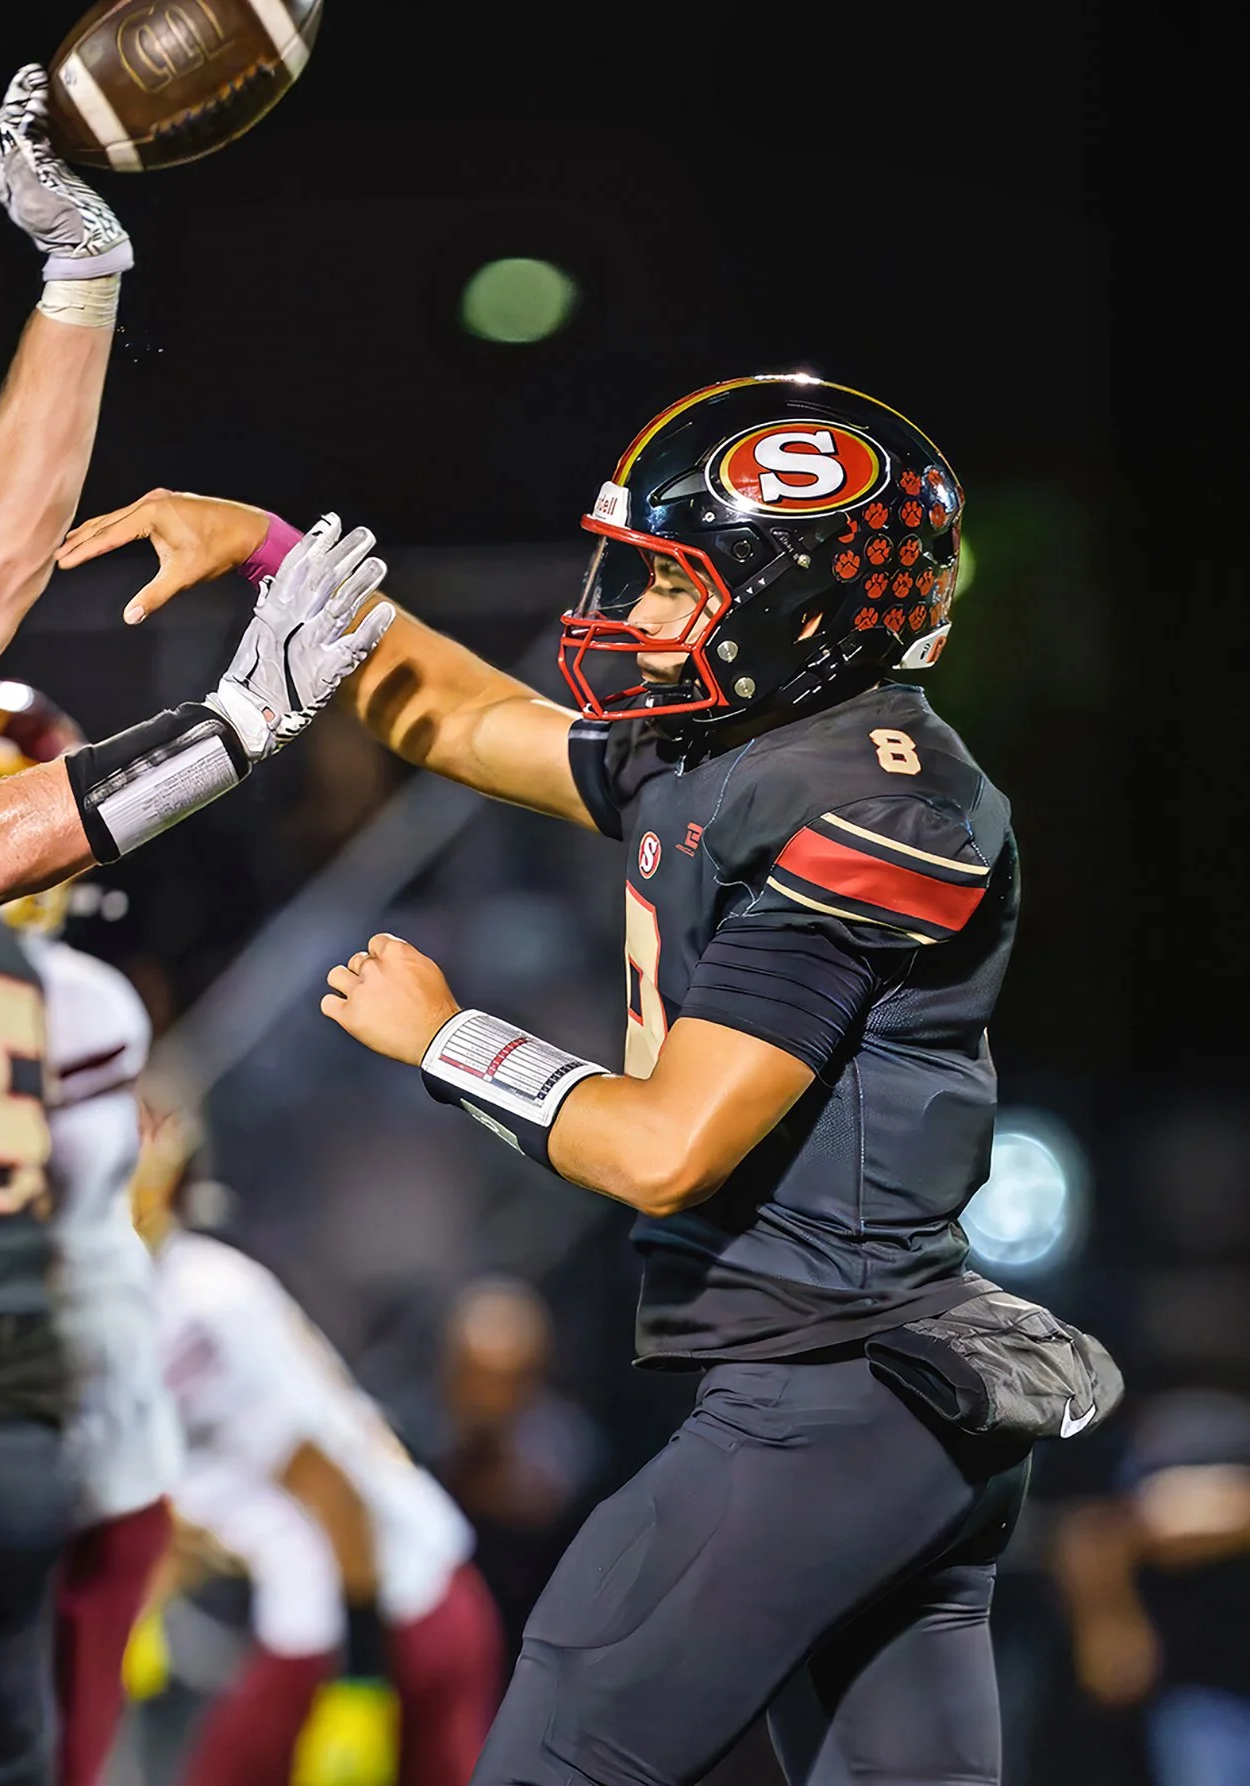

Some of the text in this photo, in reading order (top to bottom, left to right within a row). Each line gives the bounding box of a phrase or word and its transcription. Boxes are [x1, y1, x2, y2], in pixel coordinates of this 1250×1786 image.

[753, 430, 845, 503] S
[868, 728, 922, 776] 8
[639, 835, 659, 874] S
